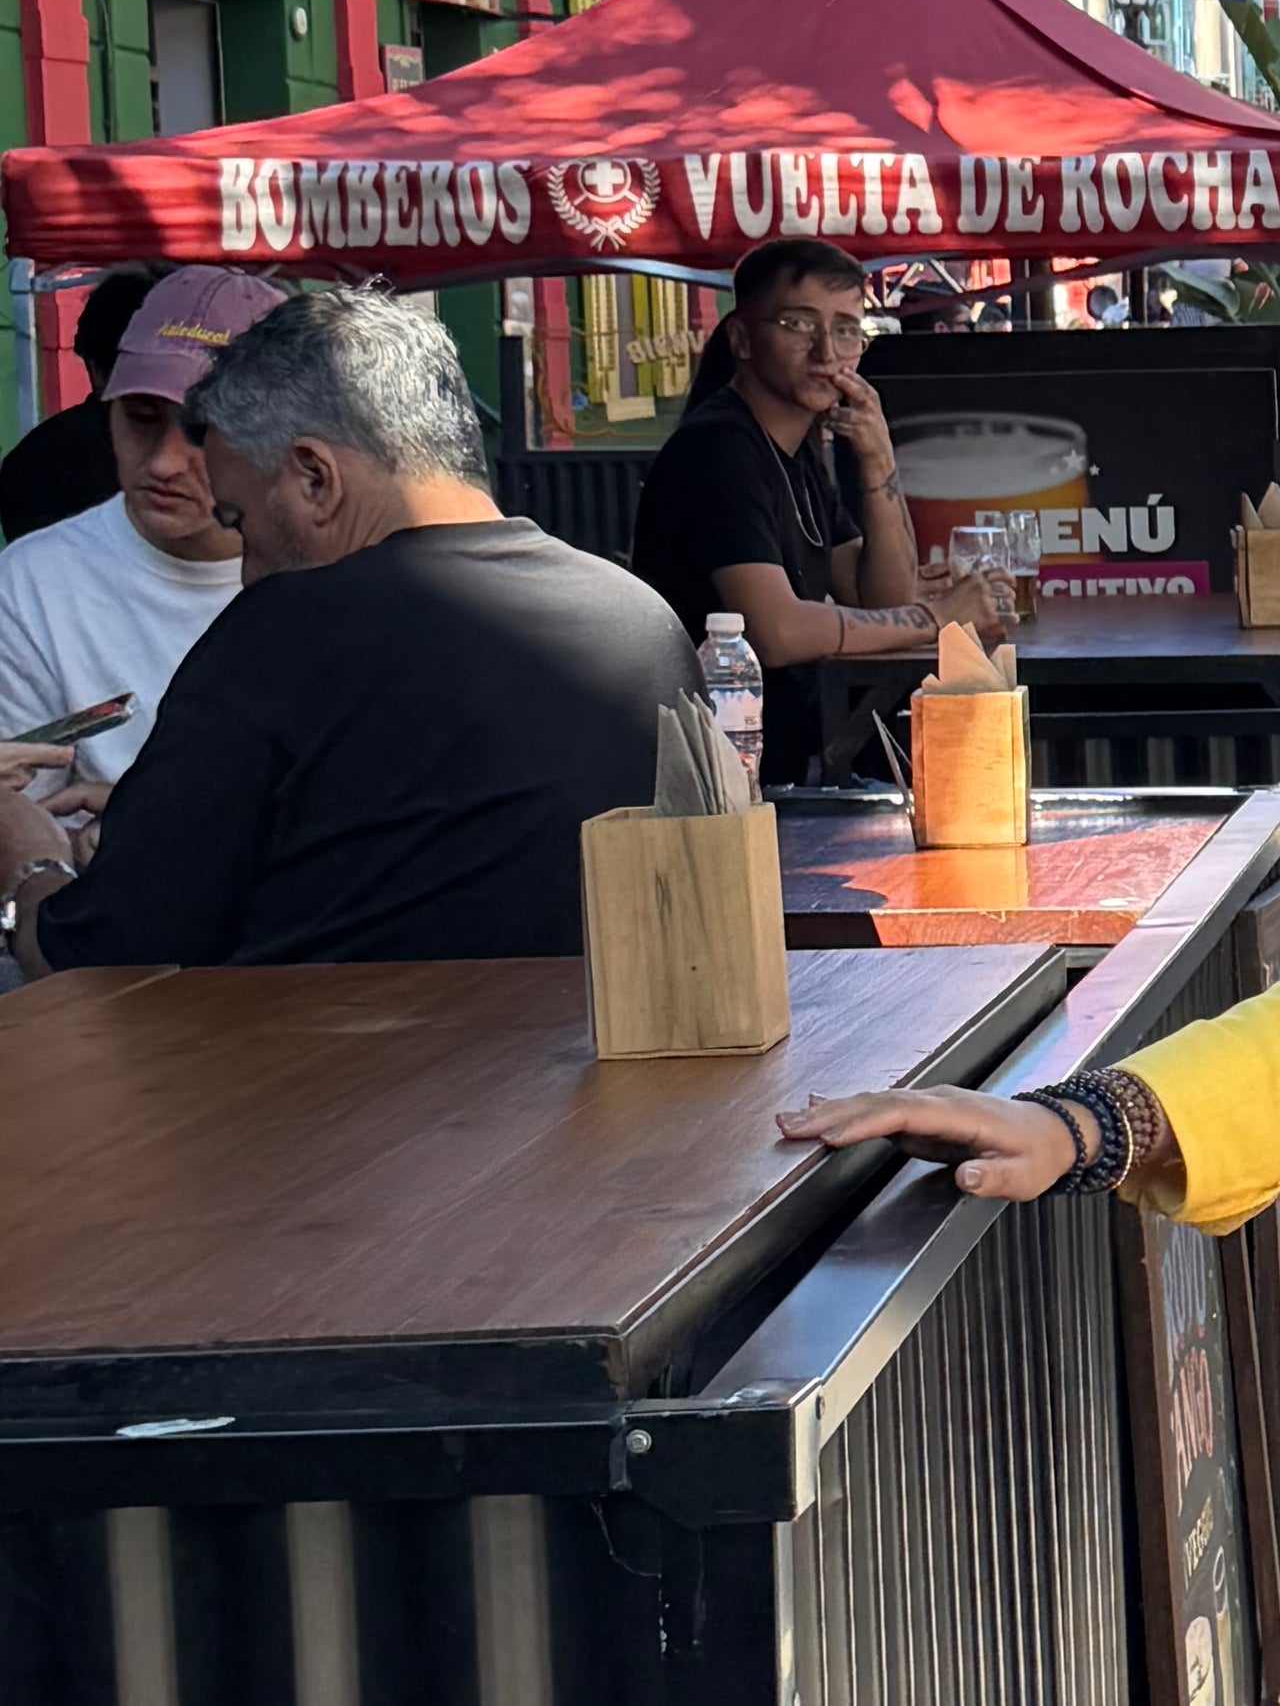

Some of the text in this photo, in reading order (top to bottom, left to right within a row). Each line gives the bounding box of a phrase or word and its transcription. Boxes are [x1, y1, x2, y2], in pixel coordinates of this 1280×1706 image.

[220, 157, 532, 252] BOMBEROS
[684, 151, 943, 241] VUELTA
[957, 154, 1045, 234] DE
[626, 329, 706, 365] BIENV
[1170, 1347, 1213, 1517] ANGO
